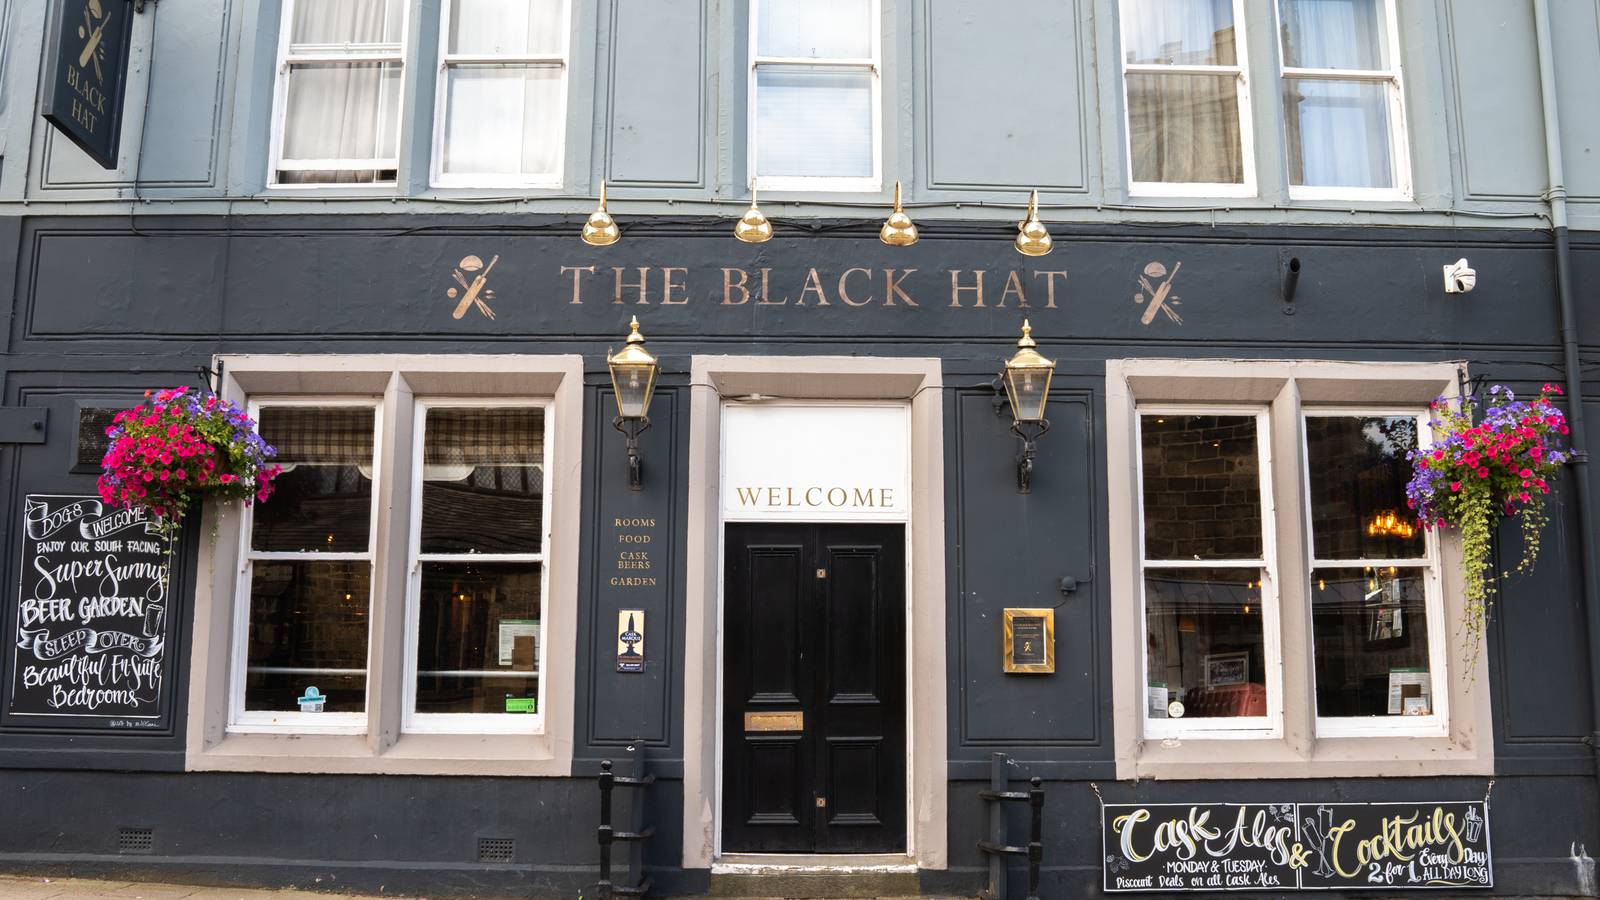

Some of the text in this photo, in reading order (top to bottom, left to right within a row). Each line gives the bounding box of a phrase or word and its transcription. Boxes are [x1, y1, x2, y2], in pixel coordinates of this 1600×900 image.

[67, 64, 106, 115] BLACK
[72, 98, 97, 133] HAT
[560, 265, 1069, 310] THE BLACK HAT
[736, 486, 894, 508] WELCOME
[41, 503, 147, 537] DOGS WELCOME
[614, 518, 656, 528] ROOMS
[37, 541, 161, 554] ENJOY OUR SOUTH FACING
[618, 534, 651, 544] FOOD
[617, 560, 651, 570] BEERS
[620, 551, 649, 561] CASK
[610, 577, 657, 587] GARDEN
[20, 596, 145, 628] BEER GARDEN
[44, 631, 145, 657] SLEEP OVER
[24, 654, 109, 690] Beautiful
[47, 685, 142, 710] Bedrooms
[1113, 805, 1291, 866] Cask Ales
[1328, 806, 1466, 878] Cocktails
[1210, 861, 1220, 873] &
[1419, 848, 1488, 868] Every Day
[1116, 872, 1280, 889] Discount Deals on all Cask Ales
[1368, 860, 1422, 885] 2 for 1
[1422, 867, 1489, 884] ALL DAY LONG
